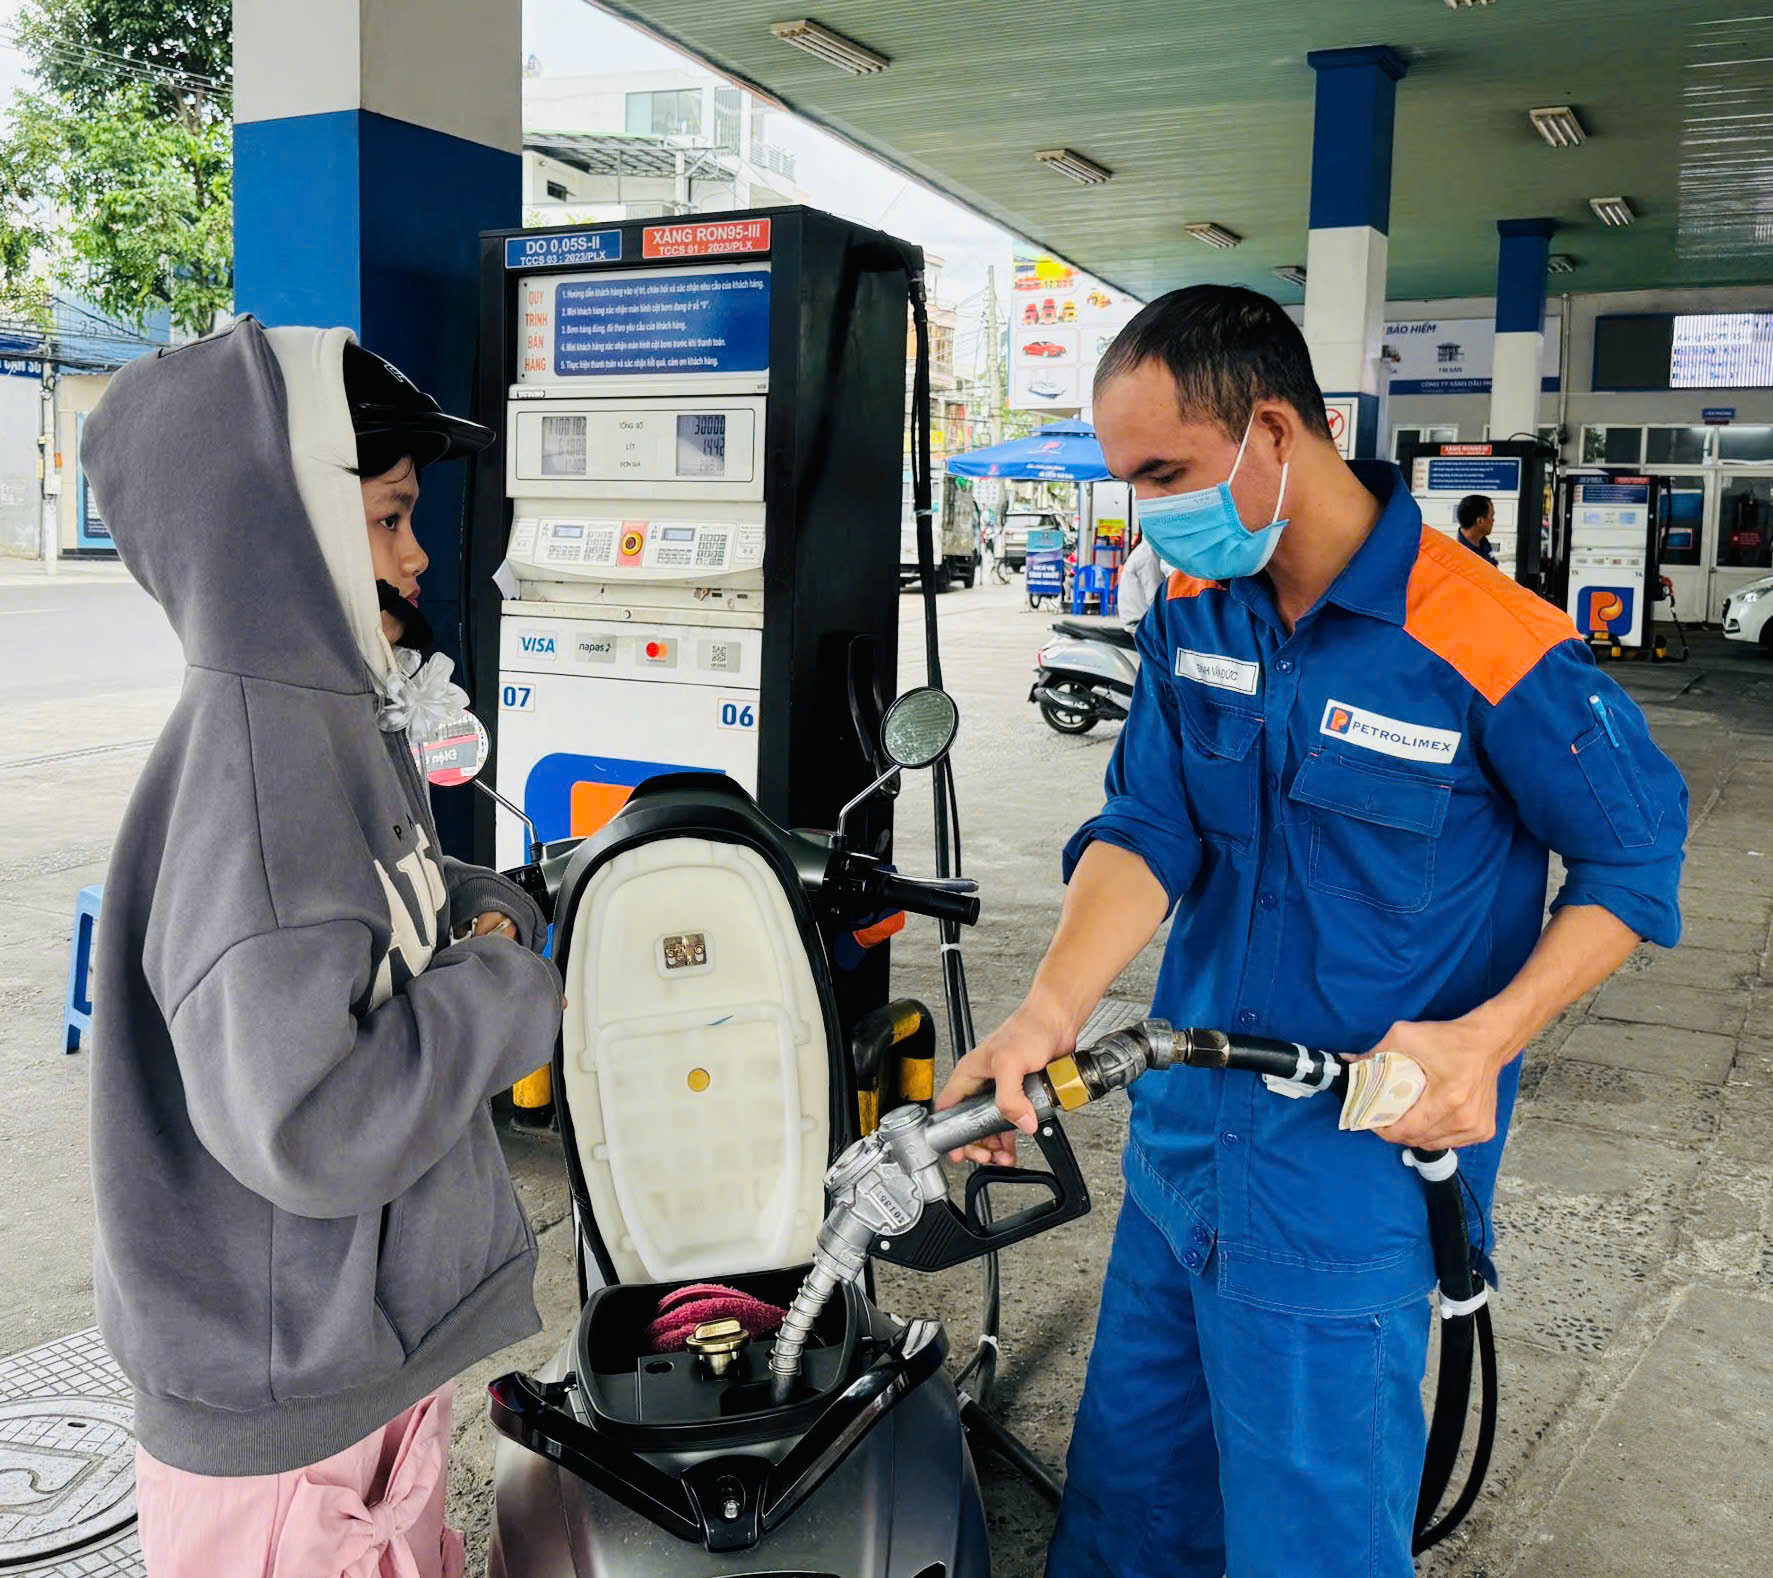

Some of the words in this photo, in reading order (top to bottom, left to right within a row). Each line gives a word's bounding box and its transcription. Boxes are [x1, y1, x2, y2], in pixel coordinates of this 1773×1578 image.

[652, 229, 692, 244] XĂNG
[696, 224, 760, 241] RON95-III
[526, 240, 546, 254] DO
[550, 236, 600, 253] 0,05S-II
[659, 245, 685, 256] TCCS
[688, 245, 698, 254] 01
[707, 241, 752, 252] 2023/PLX
[520, 256, 544, 266] TCCS
[546, 255, 558, 263] 03
[564, 251, 606, 263] 2023/PLX
[528, 291, 544, 306] QUY
[522, 636, 555, 653] VISA
[579, 643, 604, 653] napas
[503, 686, 531, 708] 07
[722, 703, 754, 727] 06
[1352, 722, 1452, 752] PETROLIMEX
